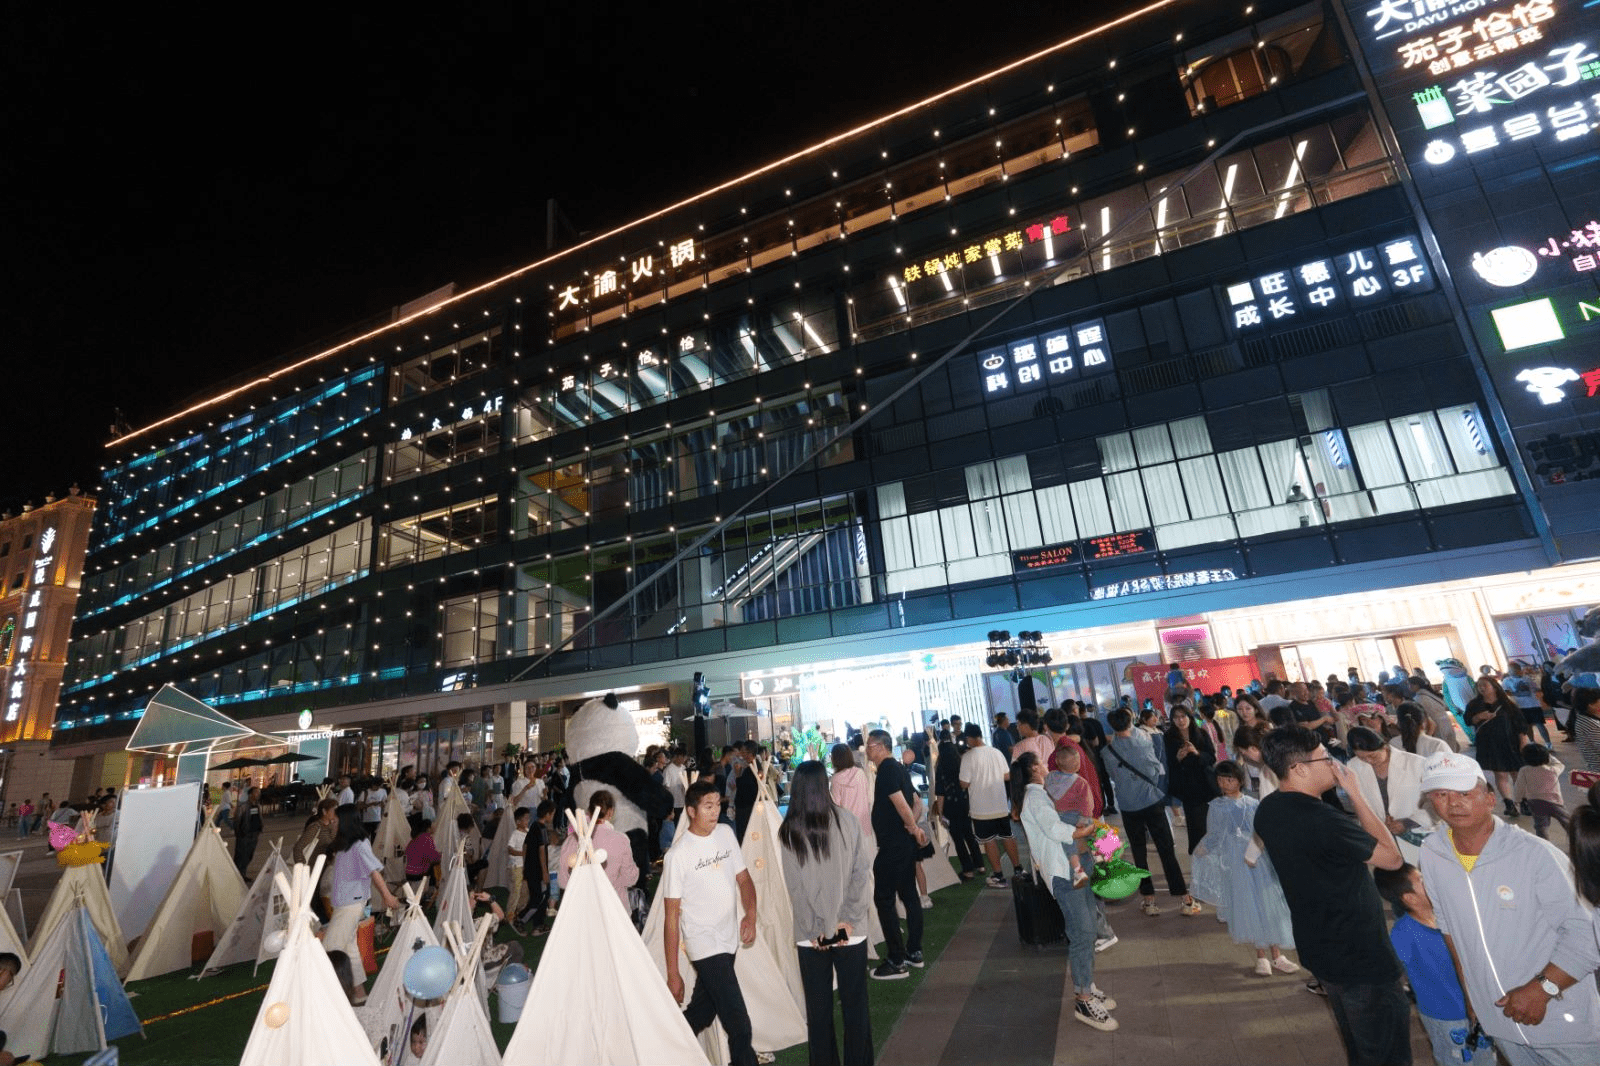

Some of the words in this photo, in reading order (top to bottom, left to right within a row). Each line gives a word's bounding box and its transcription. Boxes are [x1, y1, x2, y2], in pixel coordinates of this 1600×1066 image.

[1397, 0, 1556, 69] 茄子恰恰
[1404, 10, 1448, 33] DAYU
[1447, 43, 1598, 116] 菜园子
[558, 238, 696, 311] 大渝火锅
[1259, 240, 1418, 296] 旺德儿童
[1572, 249, 1600, 272] 自
[1235, 275, 1382, 328] 成长中心
[1394, 264, 1425, 287] 3F
[561, 336, 695, 391] 茄子恰恰
[483, 395, 503, 413] 4F
[1040, 546, 1073, 560] SALON
[287, 732, 321, 744] STARBUCKS
[322, 729, 345, 740] COFFEE
